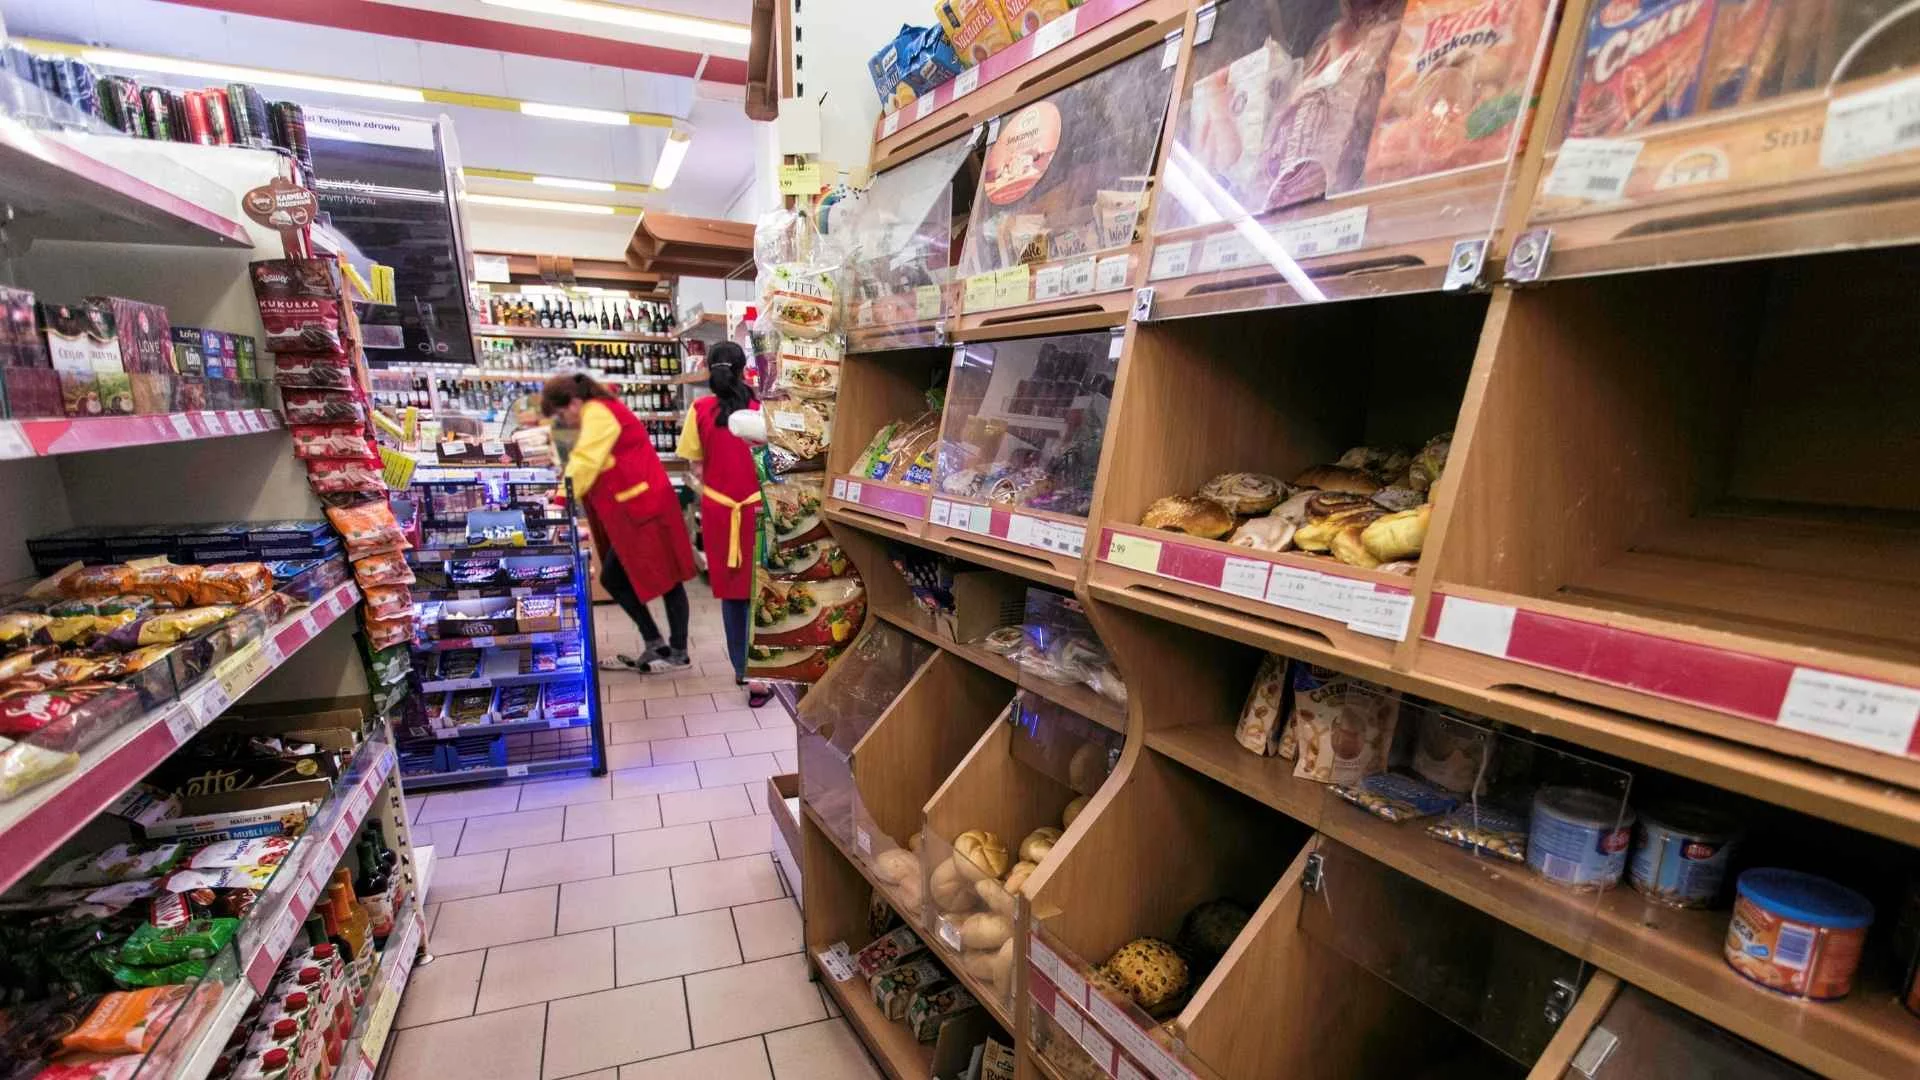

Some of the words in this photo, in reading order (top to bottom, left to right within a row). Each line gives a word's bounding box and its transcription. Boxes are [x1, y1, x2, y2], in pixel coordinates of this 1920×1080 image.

[318, 115, 361, 129] Twojemu
[787, 280, 822, 297] PITTA
[260, 300, 319, 309] KUKUŁKA
